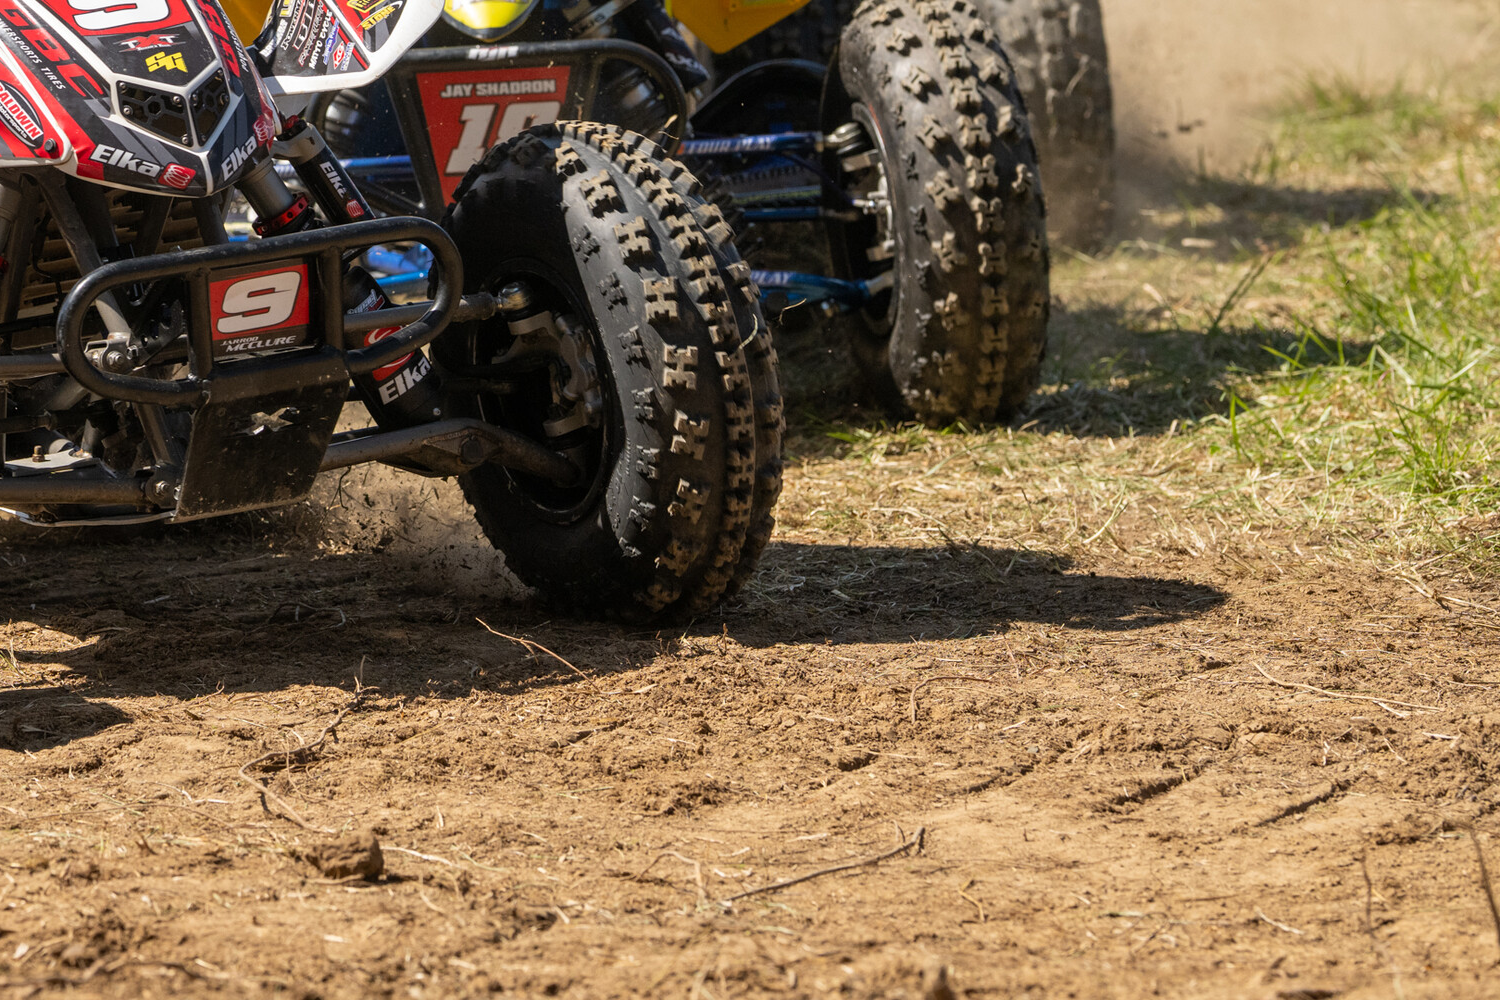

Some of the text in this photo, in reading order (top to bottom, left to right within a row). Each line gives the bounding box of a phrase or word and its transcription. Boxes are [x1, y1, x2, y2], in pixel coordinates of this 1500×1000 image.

[360, 5, 396, 31] STONE
[308, 40, 323, 70] MATTO
[320, 9, 333, 39] CYCLE
[41, 66, 66, 91] TIRES
[440, 79, 556, 98] JAY SHADRON
[90, 143, 161, 179] Elka
[221, 136, 258, 182] Elka
[319, 161, 349, 199] Elka
[215, 270, 302, 334] 9
[219, 336, 260, 347] JARROD
[226, 335, 297, 353] MCCLURE
[378, 356, 432, 405] Elka
